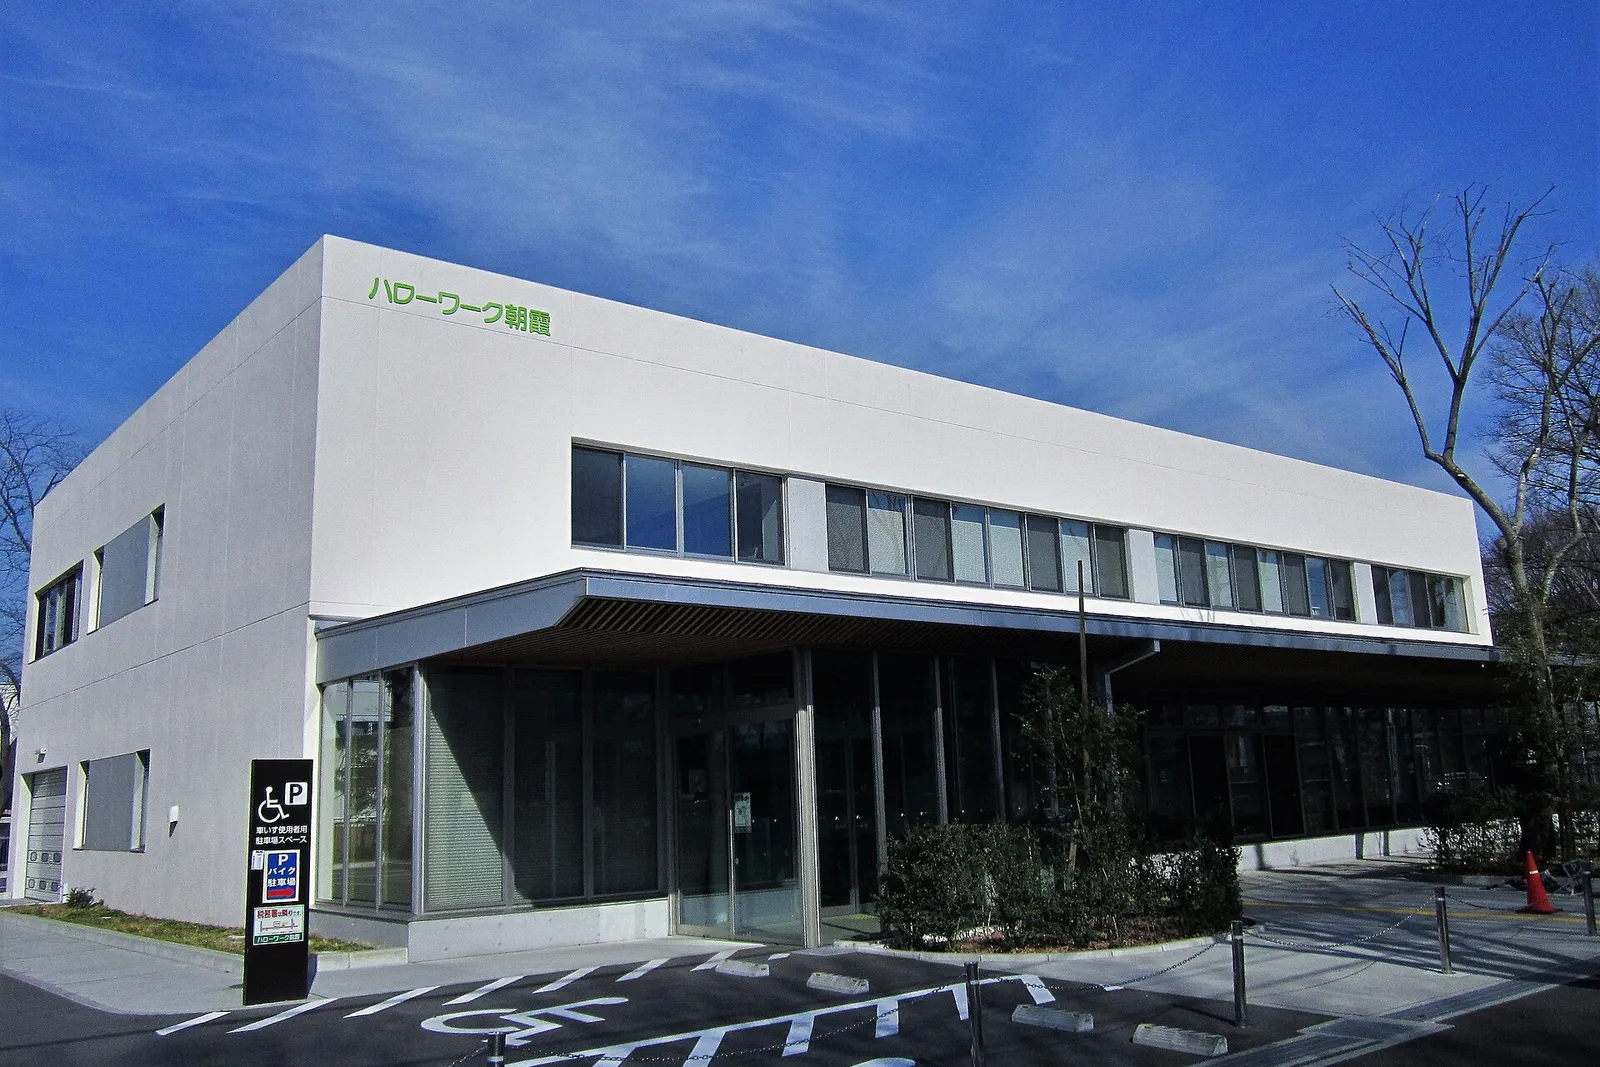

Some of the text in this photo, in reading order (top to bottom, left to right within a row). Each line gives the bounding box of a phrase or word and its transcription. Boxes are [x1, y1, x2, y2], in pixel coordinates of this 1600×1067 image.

[368, 277, 551, 336] ハローワーク朝霞
[289, 784, 303, 804] P
[256, 825, 307, 834] 車いす使用者用
[255, 835, 307, 845] 駐車場スペース
[278, 854, 289, 866] P
[268, 867, 296, 875] バイク
[267, 877, 296, 887] 駐車場
